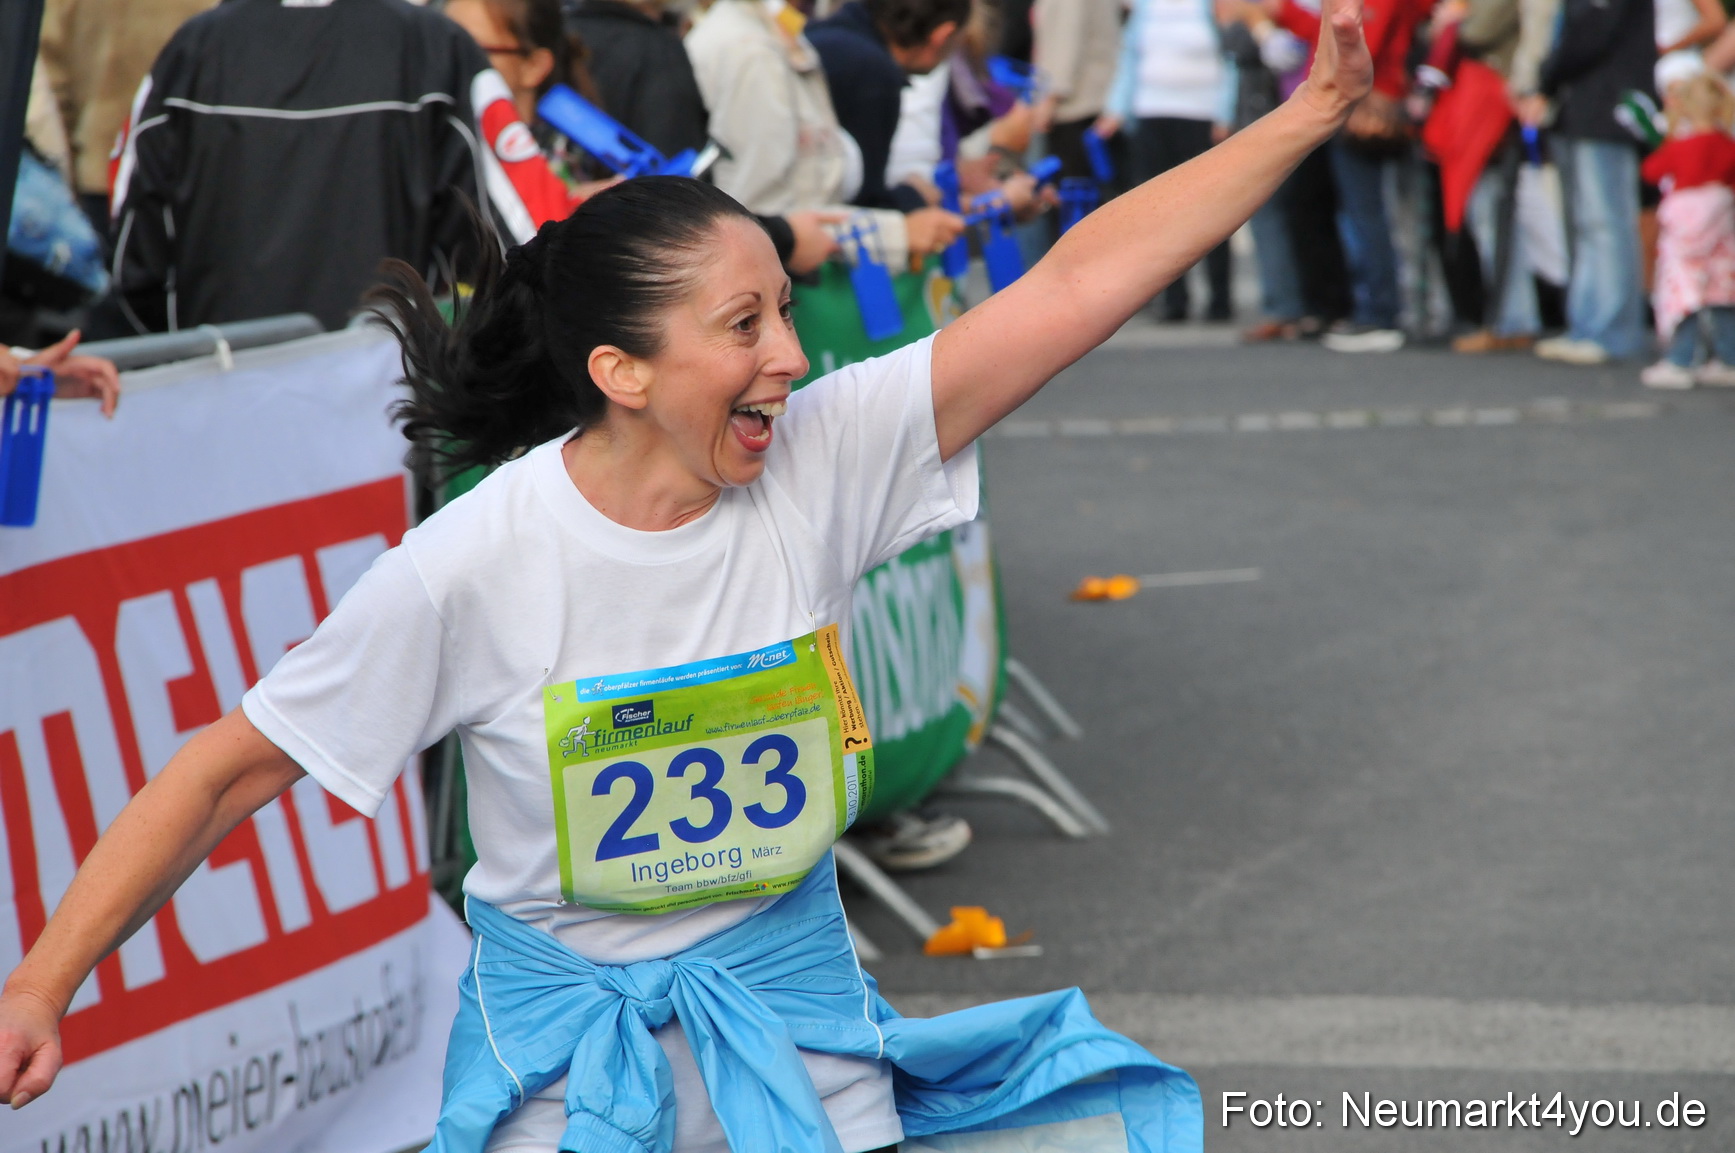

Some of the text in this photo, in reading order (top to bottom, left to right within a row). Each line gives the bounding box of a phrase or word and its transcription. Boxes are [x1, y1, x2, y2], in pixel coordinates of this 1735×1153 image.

[747, 649, 791, 668] M-net
[825, 632, 837, 667] Gutschein
[603, 681, 639, 692] oberpfälzer
[639, 676, 674, 687] firmenläufe
[675, 672, 697, 681] werden
[698, 664, 729, 679] präsentiert
[837, 672, 848, 694] Aktion
[615, 708, 651, 722] Fischer
[705, 703, 821, 735] www.firmenlauf-oberpfalz.de
[838, 694, 847, 718] könnte
[847, 700, 857, 732] Werbung
[594, 713, 694, 747] firmenlauf
[845, 737, 868, 749] ?
[595, 740, 638, 754] neumarkt
[591, 733, 807, 862] 233
[631, 845, 783, 882] Ingeborg März
[665, 870, 752, 893] Team bbw/bfz/gfi
